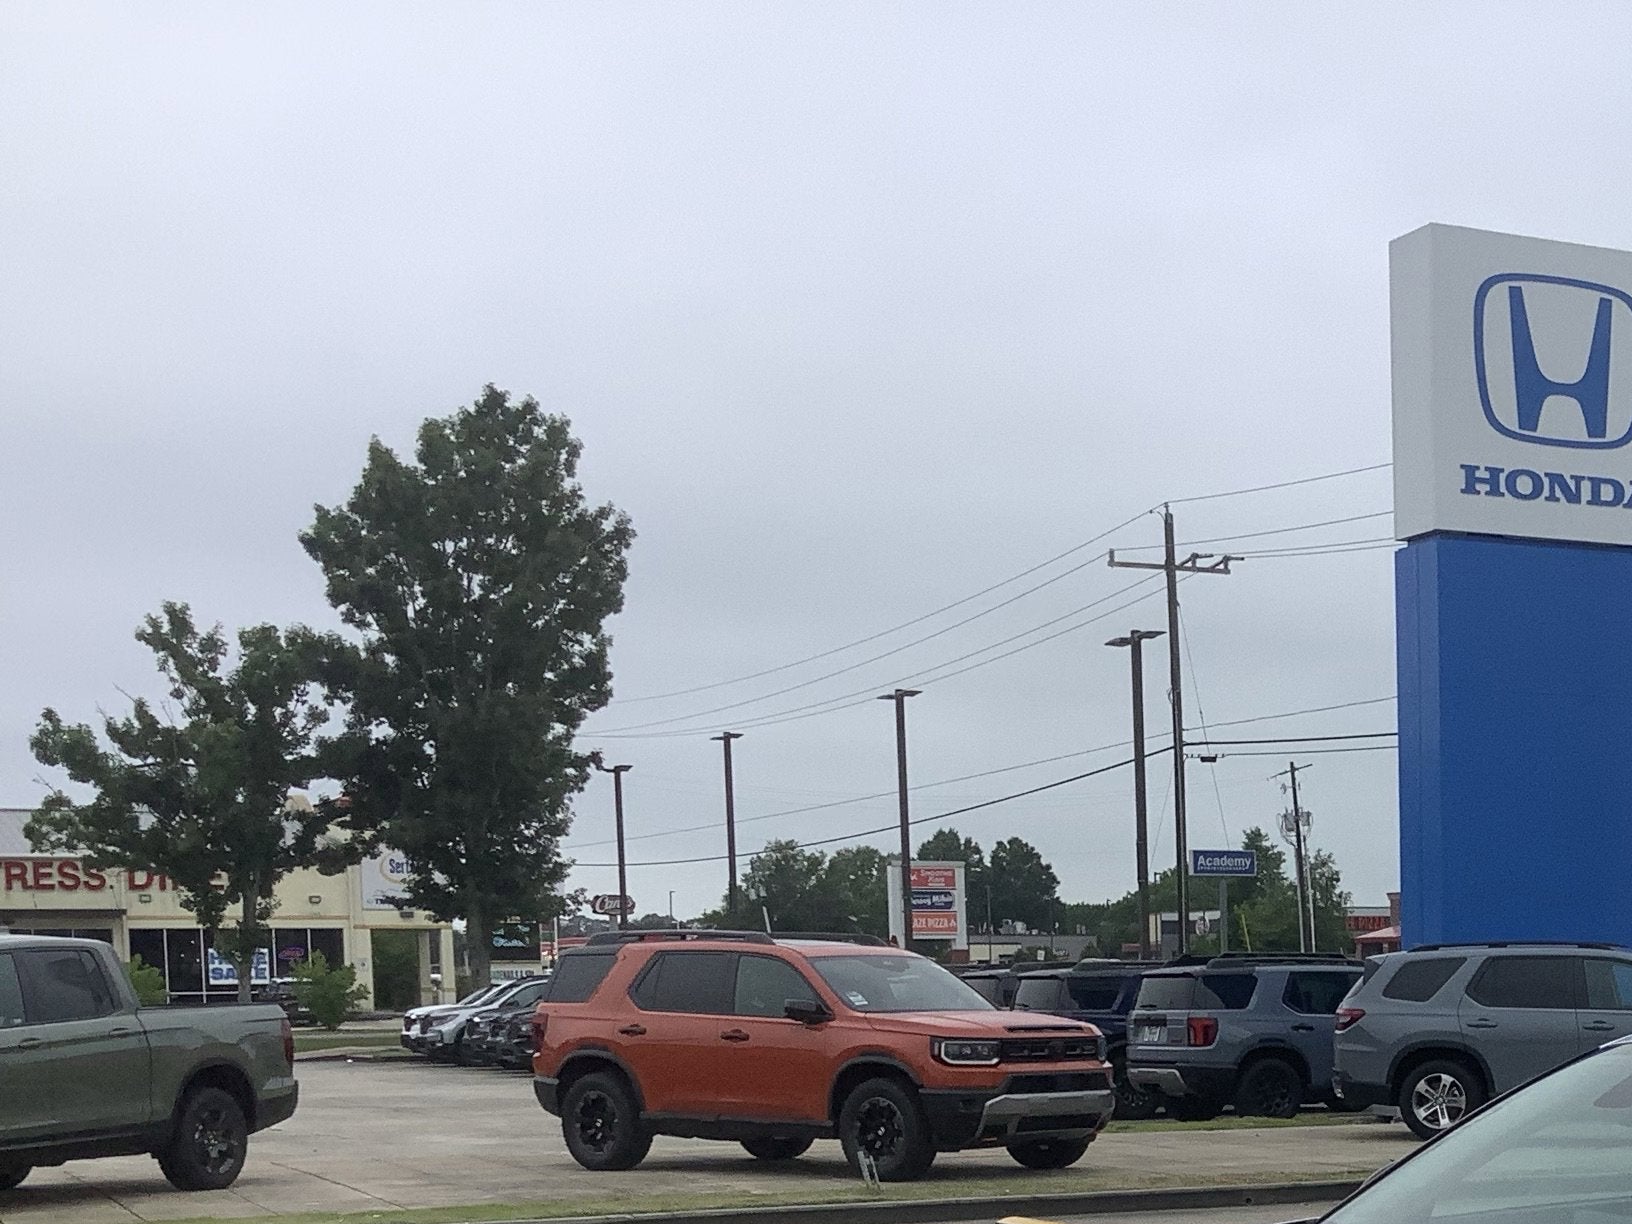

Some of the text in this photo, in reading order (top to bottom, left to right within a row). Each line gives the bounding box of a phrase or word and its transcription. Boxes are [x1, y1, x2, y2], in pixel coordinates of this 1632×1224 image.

[389, 858, 410, 874] Sert
[1197, 855, 1252, 870] Academy
[0, 860, 107, 892] RESS
[211, 967, 267, 980] SAE
